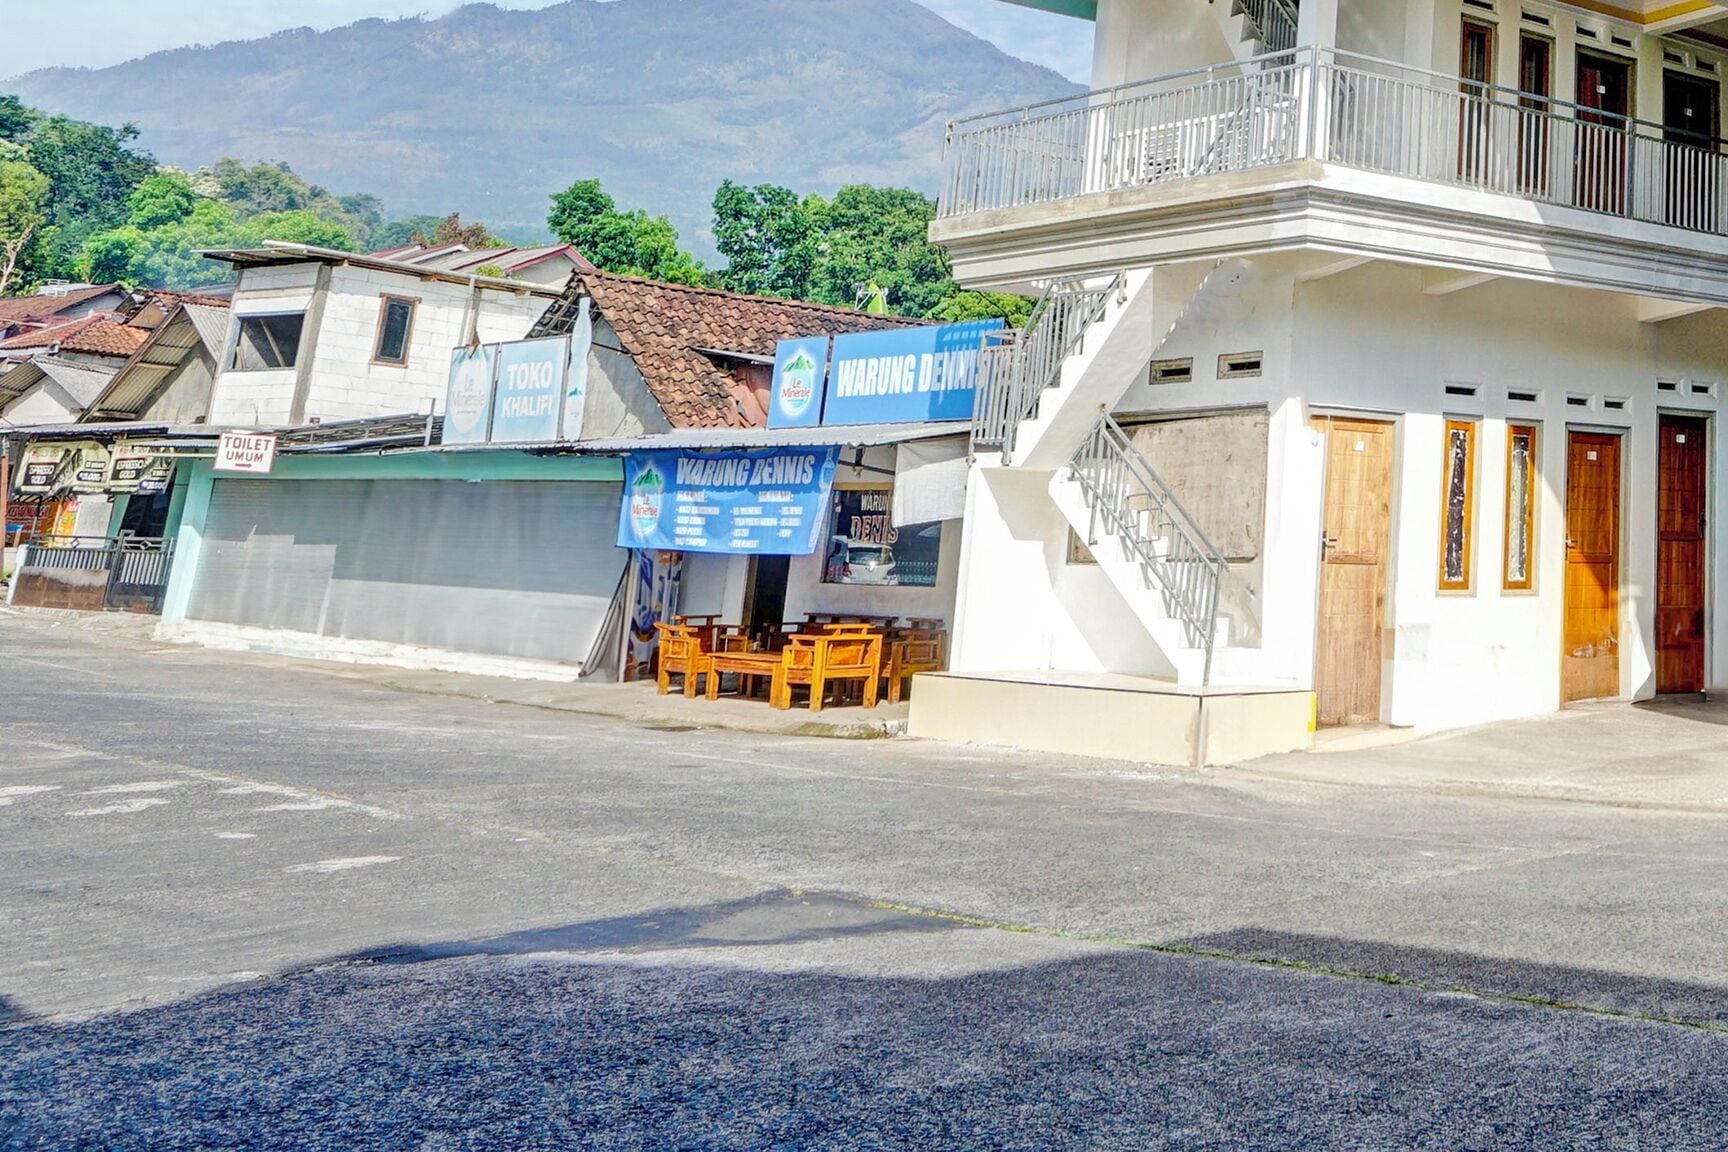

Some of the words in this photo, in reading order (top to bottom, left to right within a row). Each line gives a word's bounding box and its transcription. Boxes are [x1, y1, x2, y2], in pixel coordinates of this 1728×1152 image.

[507, 361, 553, 390] TOKO
[792, 378, 801, 389] Le
[836, 354, 916, 398] WARUNG
[782, 387, 811, 398] Minerale
[224, 436, 271, 451] TOILET
[226, 450, 263, 462] UMUM
[676, 457, 751, 486] WARUNG
[749, 455, 815, 485] DENNIS
[861, 494, 890, 511] WARUN
[851, 515, 899, 544] DENIS
